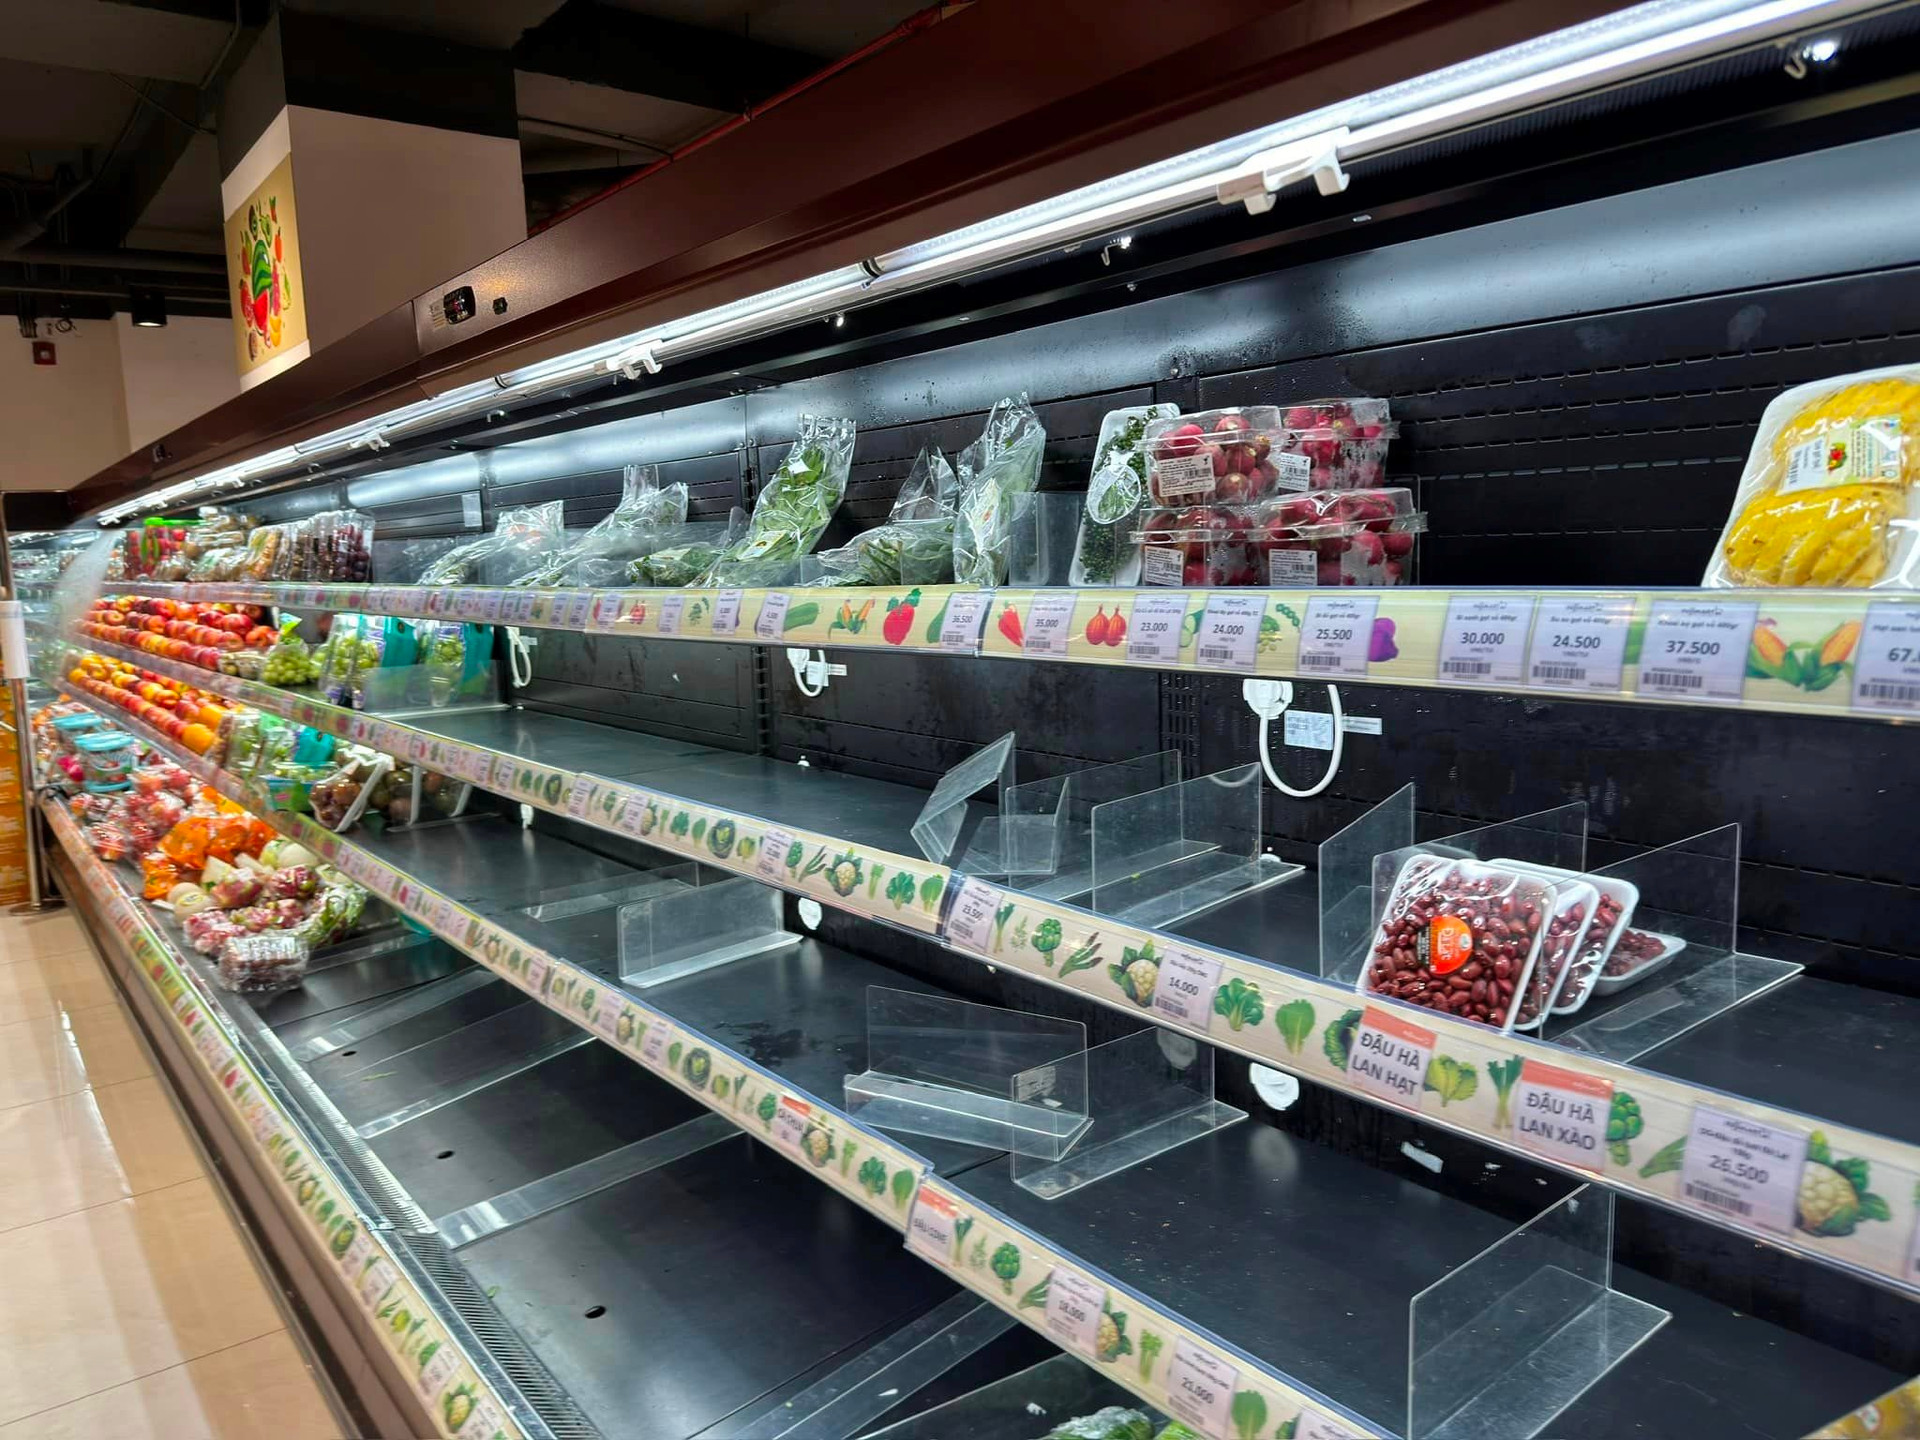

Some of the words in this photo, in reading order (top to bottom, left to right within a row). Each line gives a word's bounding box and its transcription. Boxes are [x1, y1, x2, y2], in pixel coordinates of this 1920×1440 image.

[1141, 622, 1168, 632] 23.000
[1212, 625, 1244, 636] 24.000
[1316, 629, 1353, 641] 25.500
[1461, 632, 1504, 645] 30.000
[1552, 635, 1601, 649] 24.500
[1666, 640, 1720, 656] 37.500
[1888, 647, 1920, 663] 67.
[1169, 976, 1199, 996] 14.000
[1361, 1032, 1395, 1057] ĐẬU
[1397, 1048, 1419, 1070] HÀ
[1352, 1055, 1383, 1081] LAN
[1384, 1070, 1418, 1096] HẠT
[1527, 1092, 1565, 1115] ĐẬU
[1568, 1103, 1595, 1124] HÀ
[1519, 1116, 1554, 1139] LAN
[1557, 1127, 1596, 1150] XÀO
